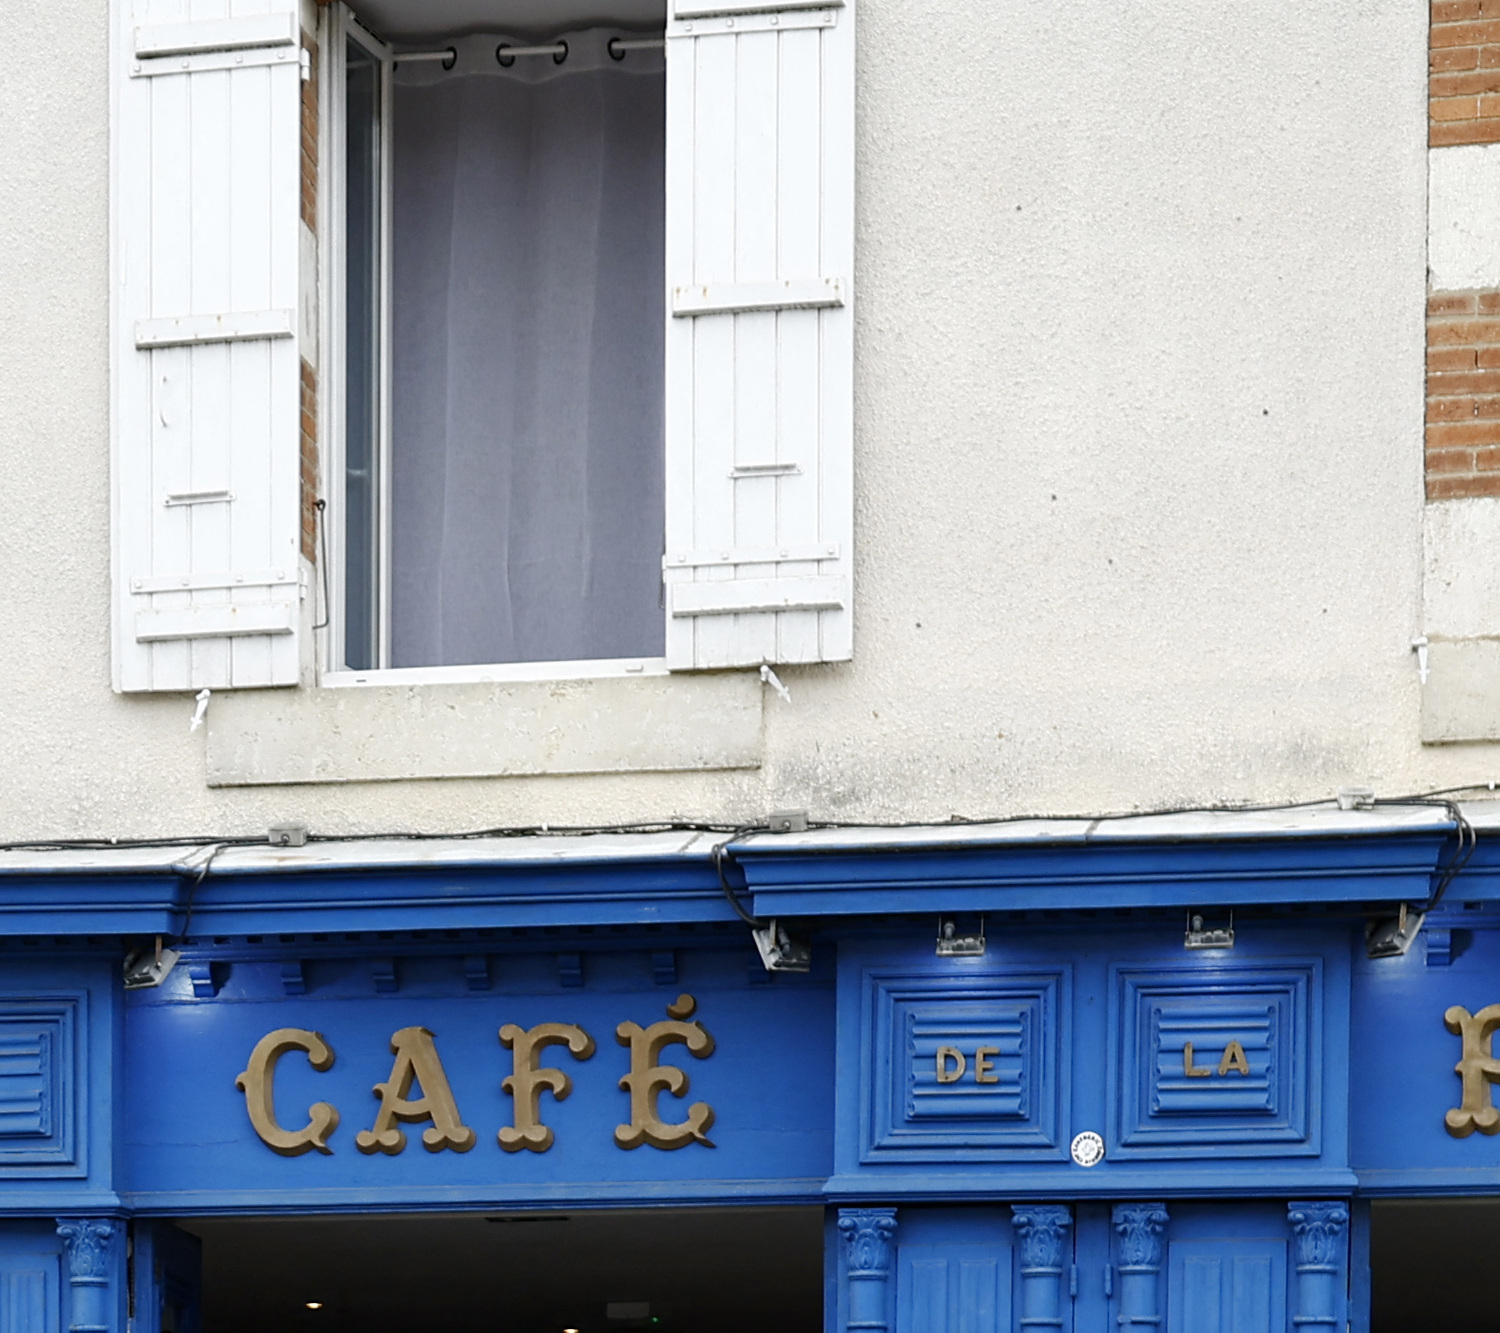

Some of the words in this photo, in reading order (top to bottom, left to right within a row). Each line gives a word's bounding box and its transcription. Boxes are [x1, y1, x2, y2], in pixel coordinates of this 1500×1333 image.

[235, 994, 717, 1156] CAFÉ
[935, 1045, 1001, 1084] DE
[1181, 1039, 1250, 1078] LA
